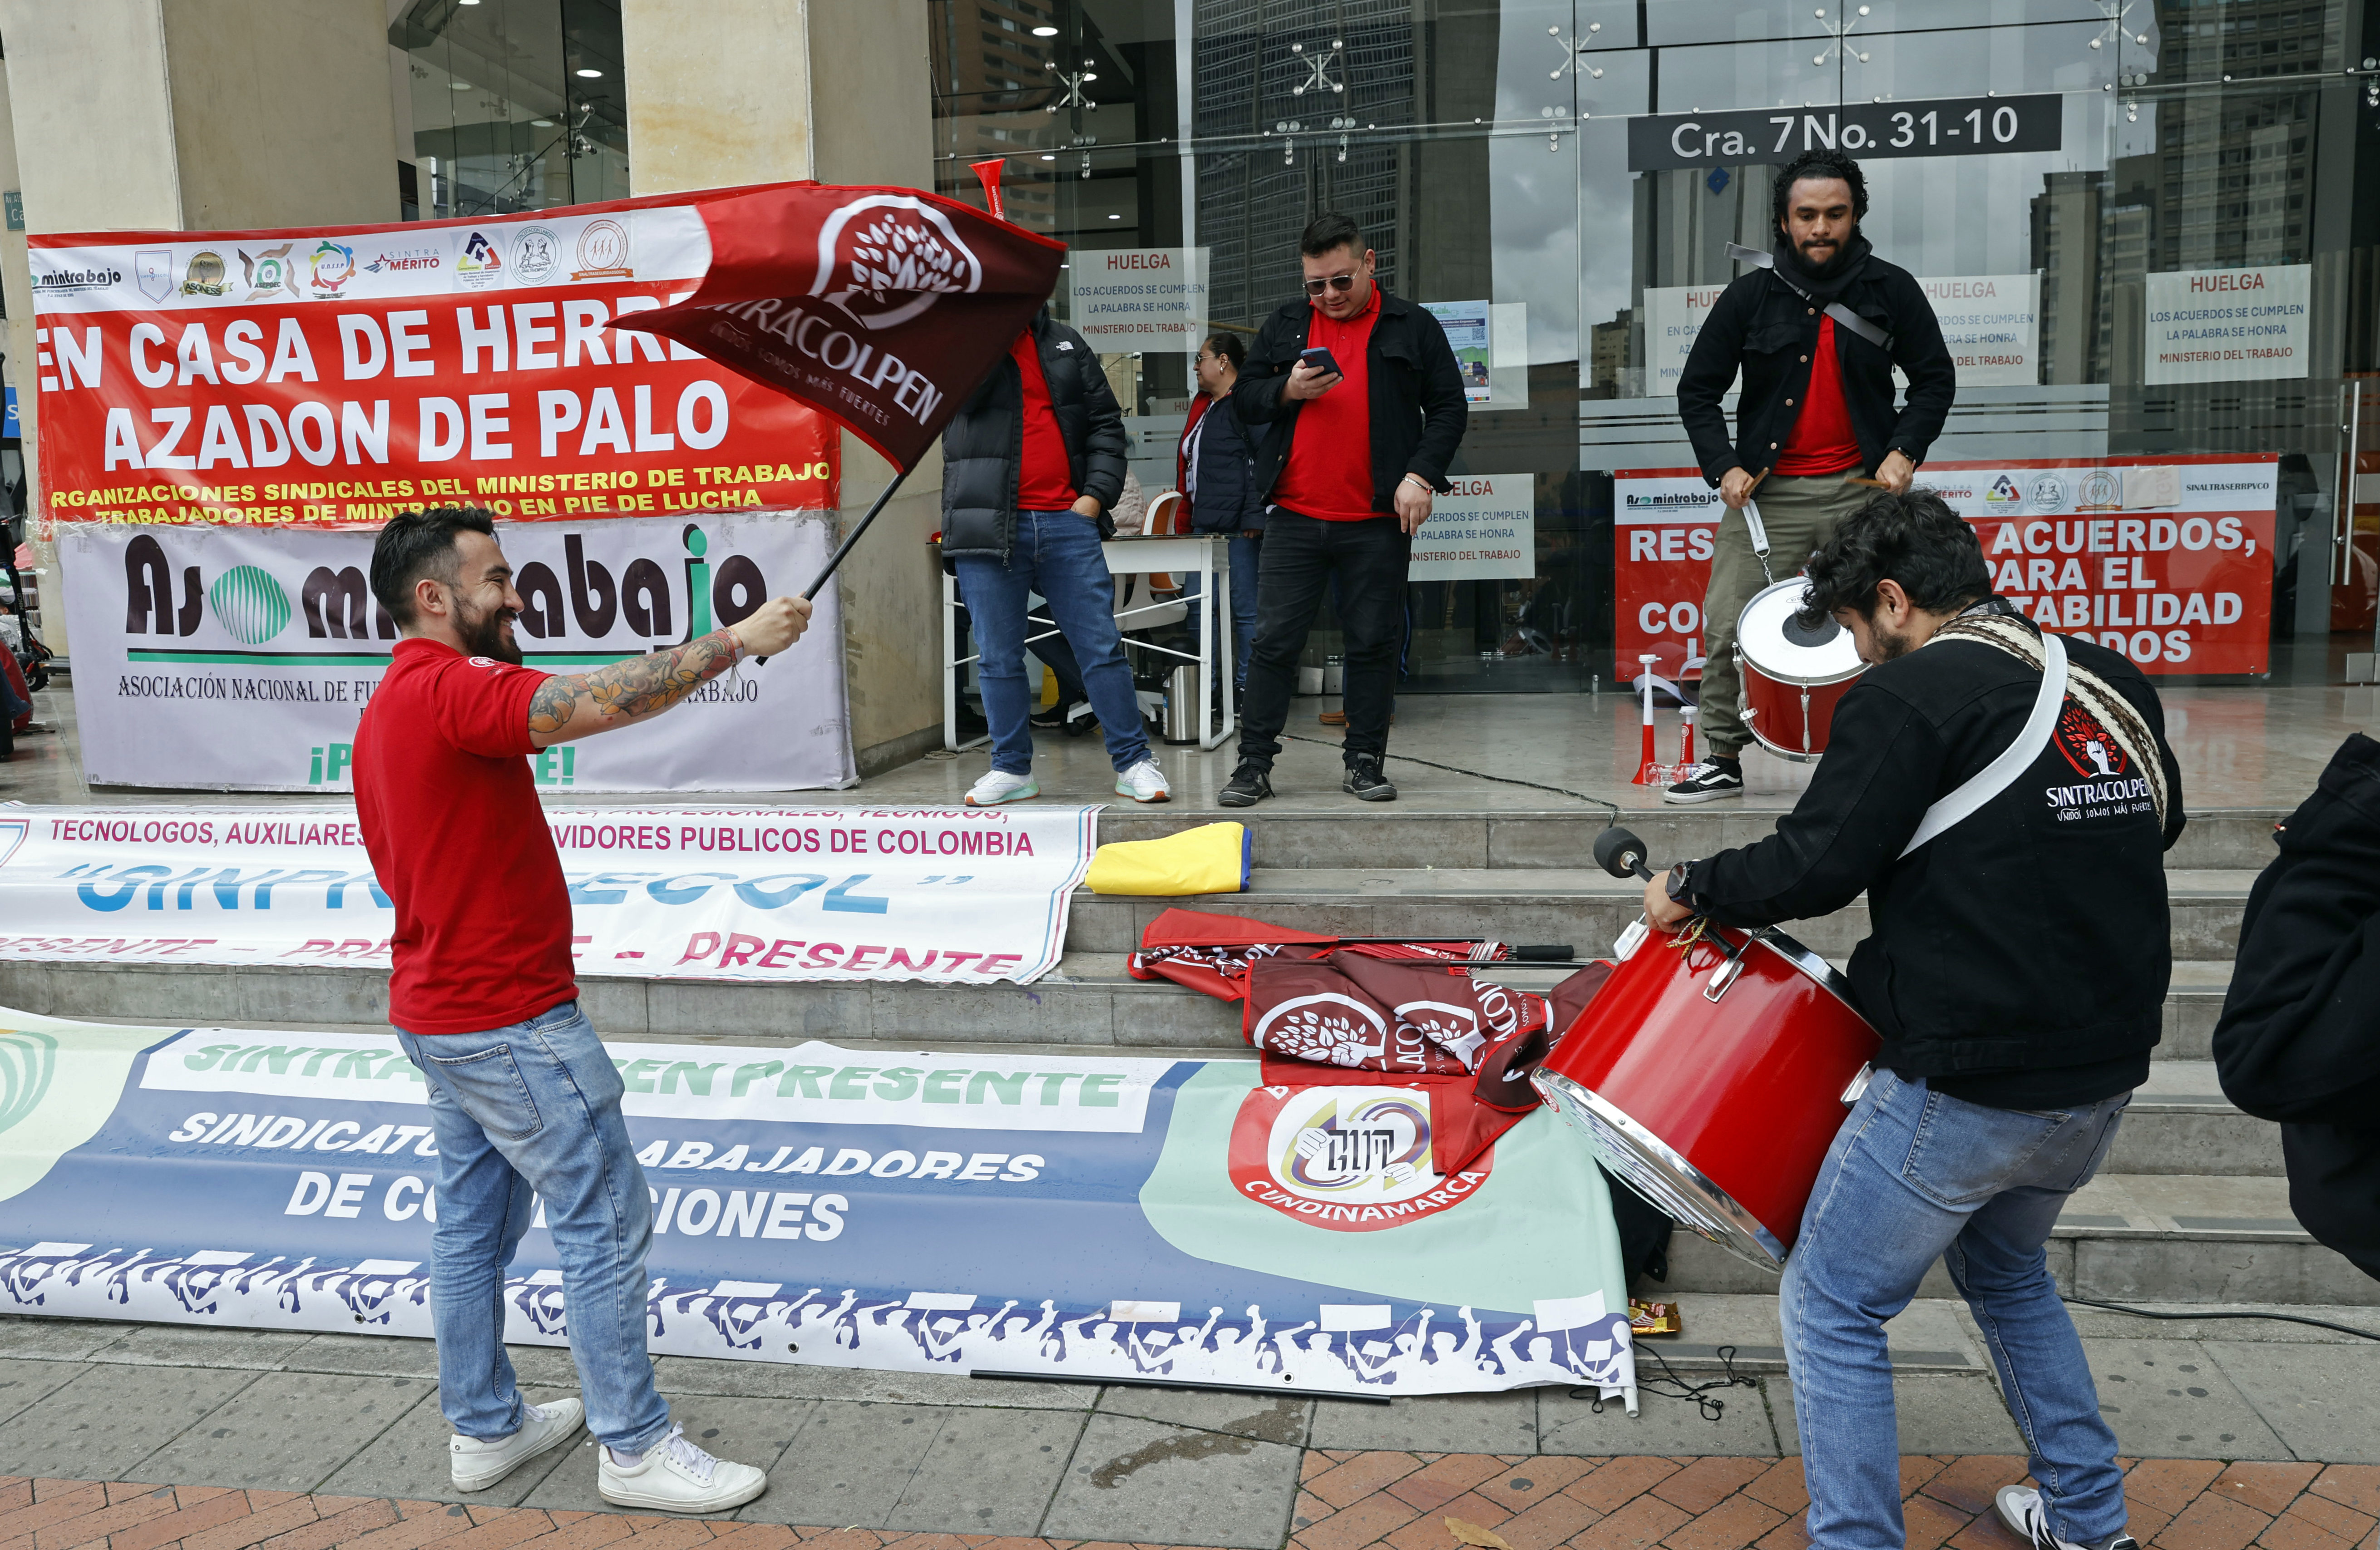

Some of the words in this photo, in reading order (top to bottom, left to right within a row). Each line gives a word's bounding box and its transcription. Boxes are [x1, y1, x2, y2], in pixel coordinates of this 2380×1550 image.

[1671, 122, 1756, 158] Cra.
[1769, 116, 1795, 153] 7
[1804, 114, 1876, 150] No.
[1889, 106, 2018, 147] 31-10
[390, 248, 439, 259] SINTRA
[1107, 253, 1170, 270] HUELGA
[390, 258, 439, 271] MÉRITO
[185, 283, 221, 295] ASONESS
[1074, 287, 1091, 296] LOS
[1093, 285, 1144, 296] ACUERDOS
[1146, 285, 1157, 294] SE
[1160, 284, 1205, 294] CUMPLEN
[1925, 281, 1997, 299] HUELGA
[2191, 273, 2265, 293] HUELGA
[1088, 304, 1099, 313] LA
[1101, 303, 1141, 313] PALABRA
[1143, 303, 1154, 311] SE
[1157, 302, 1190, 311] HONRA
[2151, 312, 2171, 322] LOS
[2173, 308, 2233, 321] ACUERDOS
[2236, 307, 2248, 317] SE
[2251, 304, 2304, 317] CUMPLEN
[1968, 315, 1980, 325] SE
[1983, 314, 2034, 324] CUMPLEN
[1083, 324, 1134, 335] MINISTERIO
[1137, 323, 1154, 333] DEL
[1156, 323, 1196, 333] TRABAJO
[1668, 326, 1680, 336] EN
[2167, 331, 2179, 341] LA
[2182, 328, 2230, 340] PALABRA
[2232, 327, 2245, 337] SE
[2248, 324, 2287, 336] HONRA
[1965, 334, 1977, 344] SE
[1980, 333, 2017, 343] HONRA
[129, 317, 319, 389] CASA
[337, 310, 435, 380] DE
[2160, 350, 2221, 363] MINISTERIO
[2224, 350, 2244, 360] DEL
[2246, 347, 2293, 359] TRABAJO
[1957, 356, 1976, 366] DEL
[1978, 355, 2023, 365] TRABAJO
[104, 400, 390, 472] AZADON
[418, 392, 513, 463] DE
[538, 380, 729, 458] PALO
[51, 484, 256, 508] RGANIZACIONES
[264, 479, 415, 503] SINDICALES
[420, 478, 469, 496] DEL
[477, 470, 638, 494] MINISTERIO
[647, 468, 685, 488] DE
[693, 462, 830, 485] TRABAJO
[1432, 480, 1493, 497] ELGA
[95, 505, 296, 524] TRABAJADORES
[303, 504, 336, 522] DE
[519, 498, 557, 516] EN
[564, 495, 610, 513] PIE
[617, 494, 655, 512] DE
[662, 489, 763, 510] LUCHA
[1468, 512, 1480, 521] SE
[1482, 510, 1529, 521] CUMPLEN
[1412, 532, 1419, 540] A
[1421, 530, 1463, 540] PALABRA
[1466, 529, 1477, 539] SE
[1480, 528, 1515, 538] HONRA
[1991, 517, 2256, 558] ACUERDOS,
[1410, 551, 1457, 561] INISTERIO
[1459, 551, 1477, 560] DEL
[1479, 550, 1521, 560] TRABAJO
[2103, 557, 2156, 589] EL
[119, 672, 227, 700] ASOCIACIÓN
[231, 677, 320, 703] NACIONAL
[324, 681, 348, 702] DE
[2057, 808, 2082, 822] UNIDOS
[2086, 806, 2110, 819] SOMOS
[2113, 801, 2128, 815] MÁS
[51, 819, 218, 849] TECNOLOGOS,
[548, 825, 671, 850] VIDORES
[681, 827, 820, 854] PUBLICOS
[830, 829, 868, 853] DE
[877, 829, 1034, 857] COLOMBIA
[672, 931, 1023, 975] PRESENTE
[730, 1059, 1127, 1108] PRESENTE
[632, 1140, 1045, 1182] ABAJADORES
[284, 1171, 374, 1219] DE
[1245, 1170, 1487, 1222] CUNDINAMARCA
